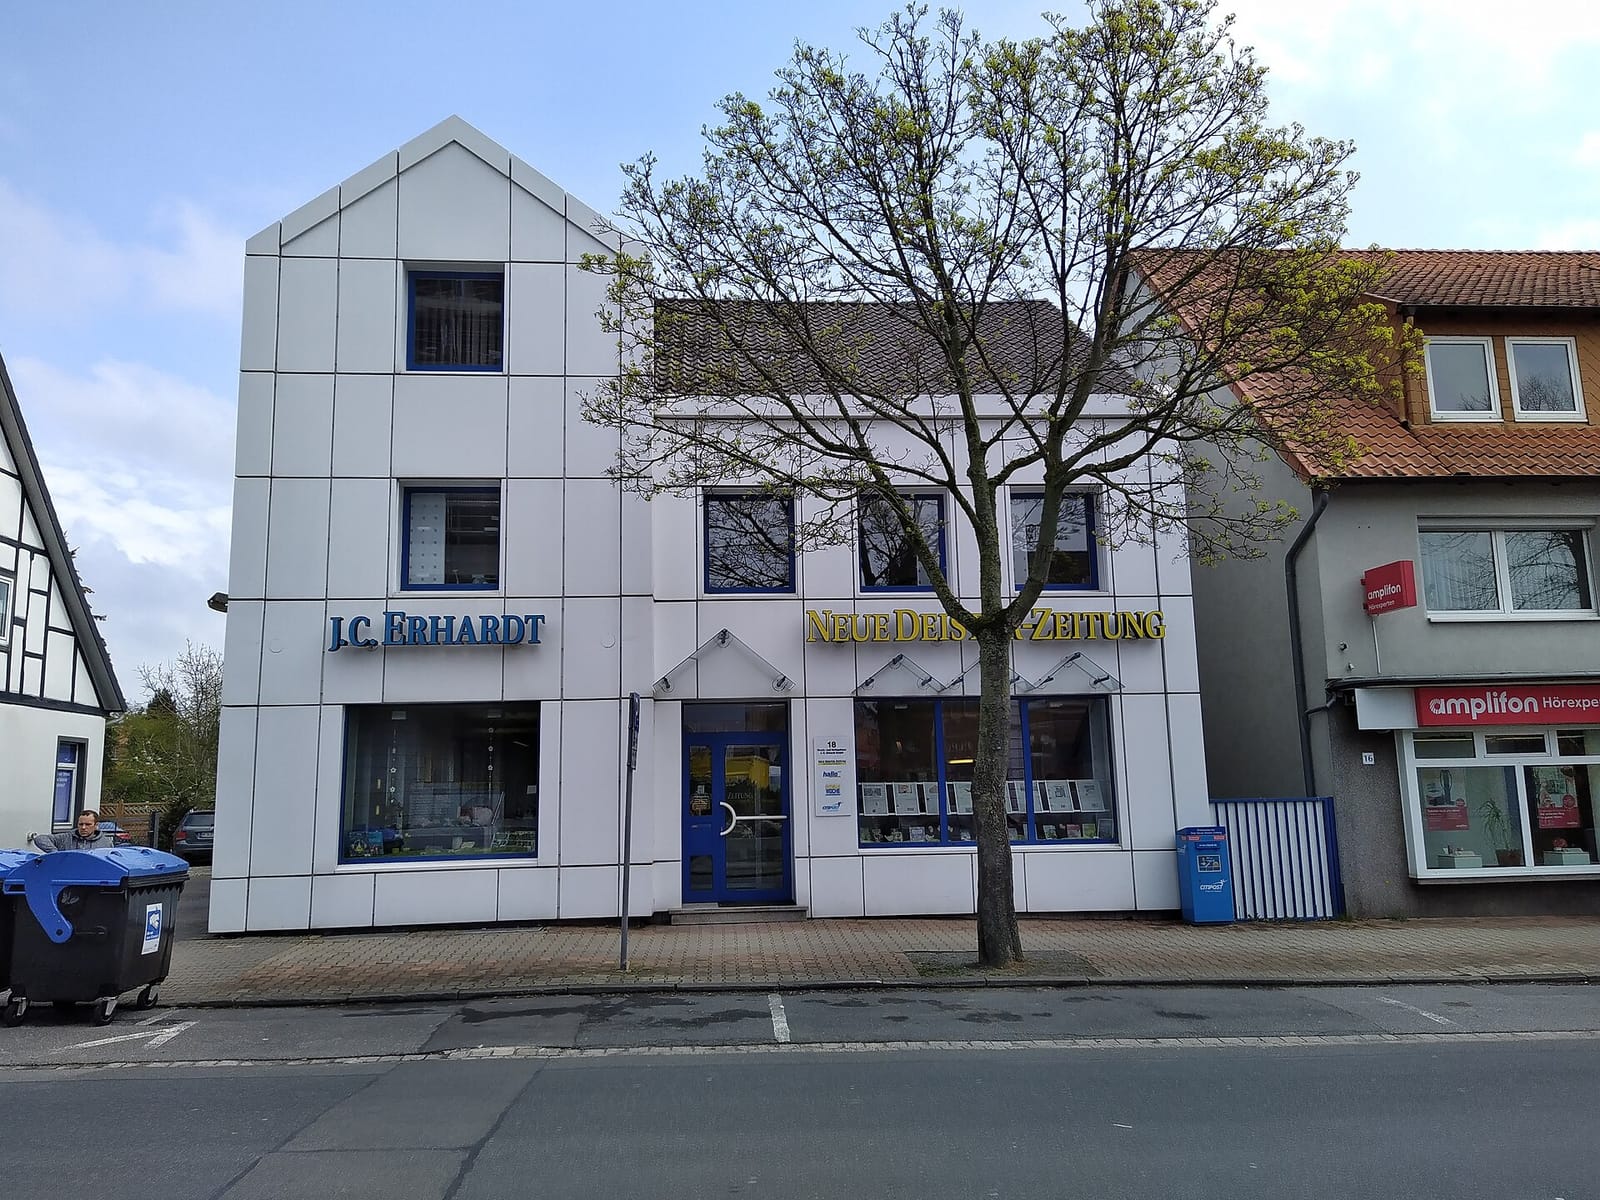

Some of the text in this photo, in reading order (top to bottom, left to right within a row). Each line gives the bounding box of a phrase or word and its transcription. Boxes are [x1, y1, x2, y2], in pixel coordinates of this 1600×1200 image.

[1368, 583, 1401, 600] amplifon
[328, 611, 545, 651] J.C. ERHARDT
[806, 608, 1167, 643] NEUE DEIS-ZEITUNG
[1429, 691, 1600, 720] amplifon Hörexpe
